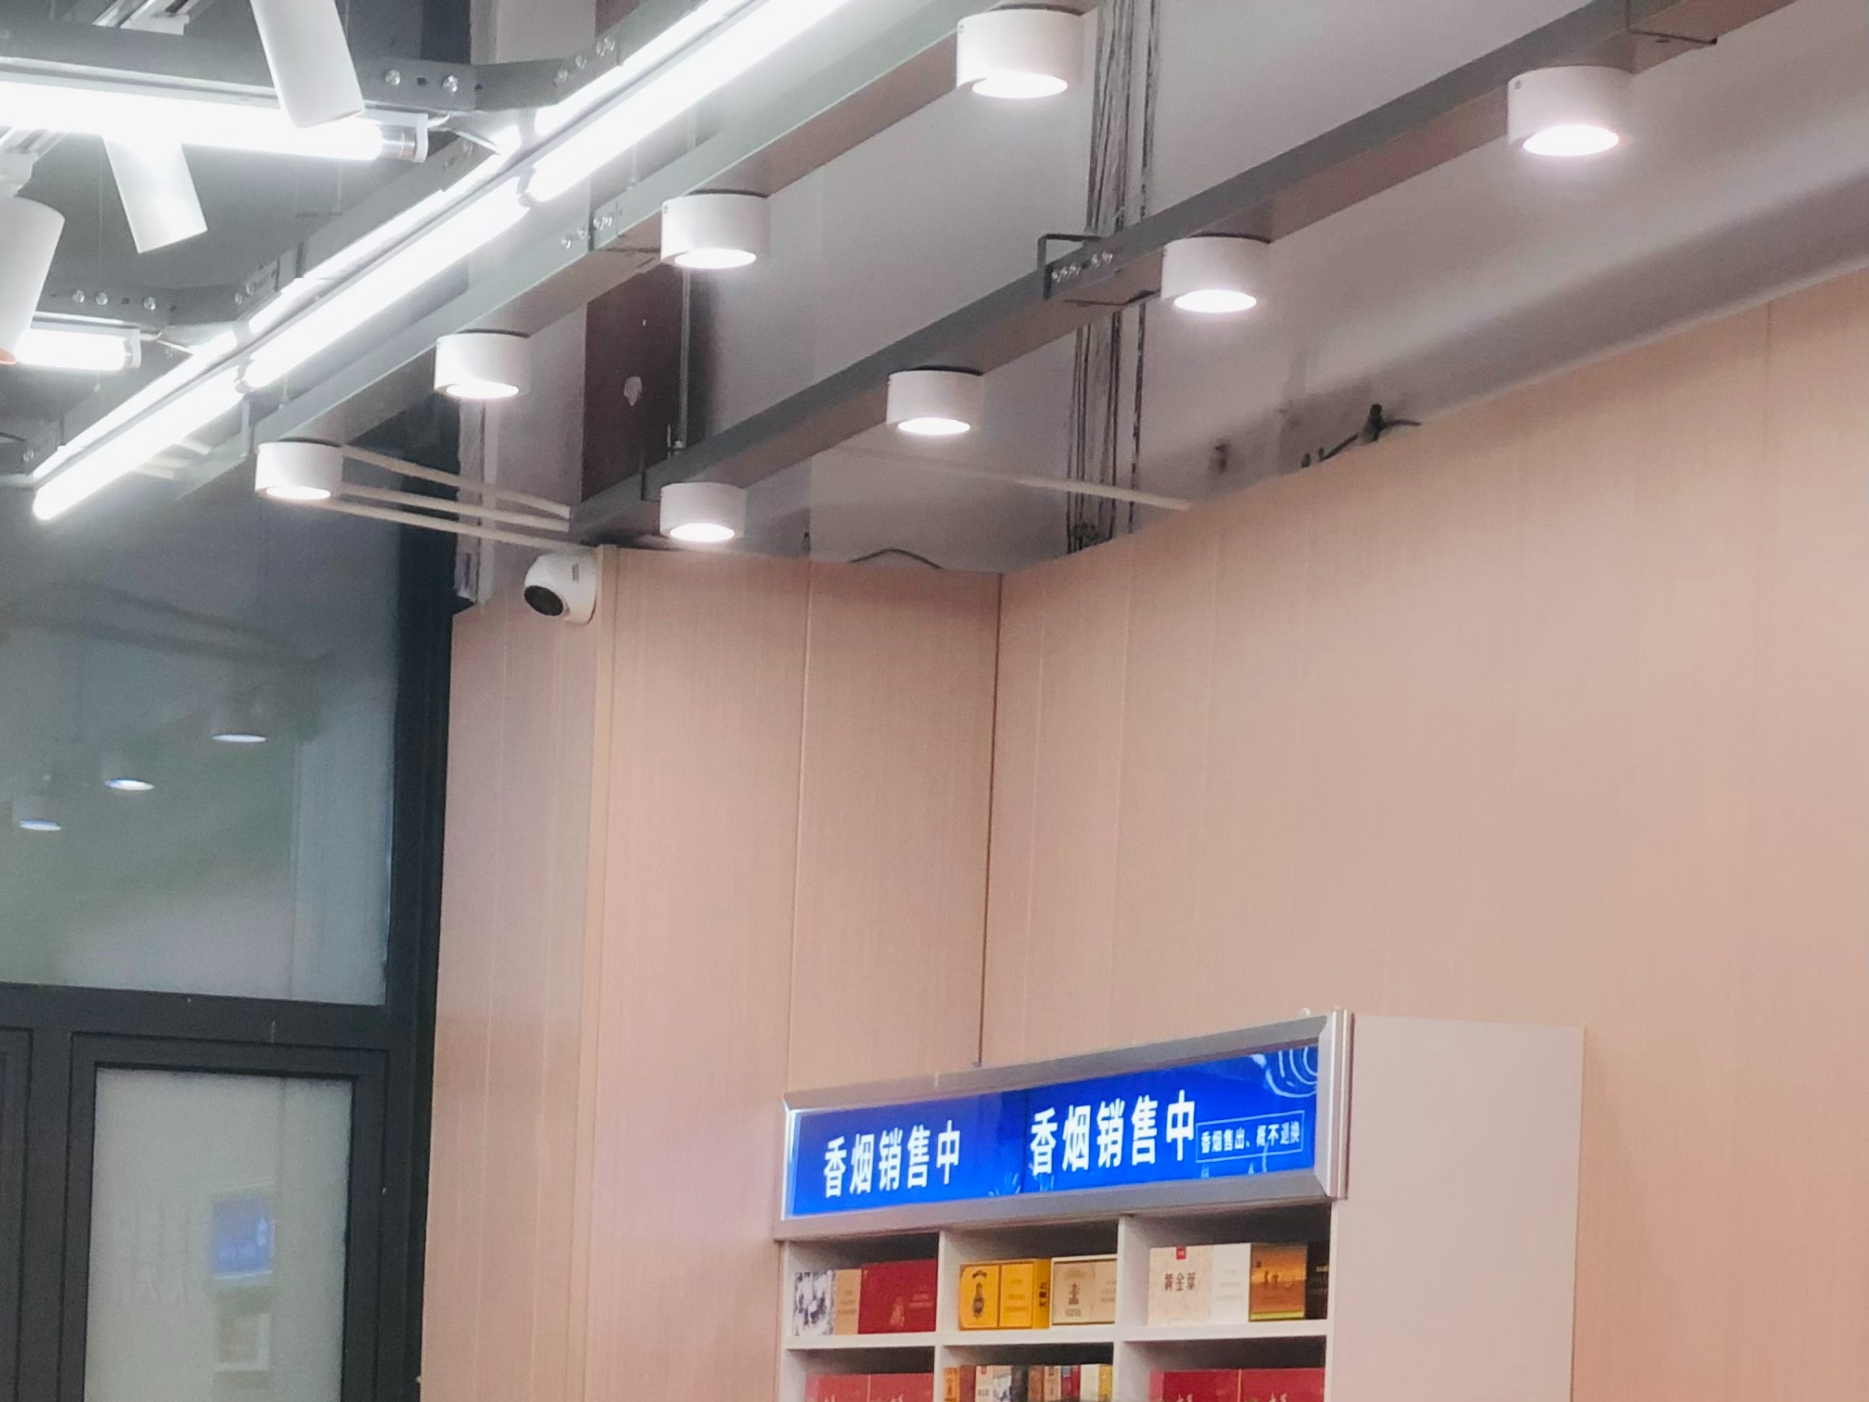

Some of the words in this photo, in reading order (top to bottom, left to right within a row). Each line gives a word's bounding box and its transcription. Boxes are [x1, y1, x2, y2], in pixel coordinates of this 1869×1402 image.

[823, 1119, 961, 1199] 香烟销售中
[1030, 1089, 1196, 1177] 香烟销售中
